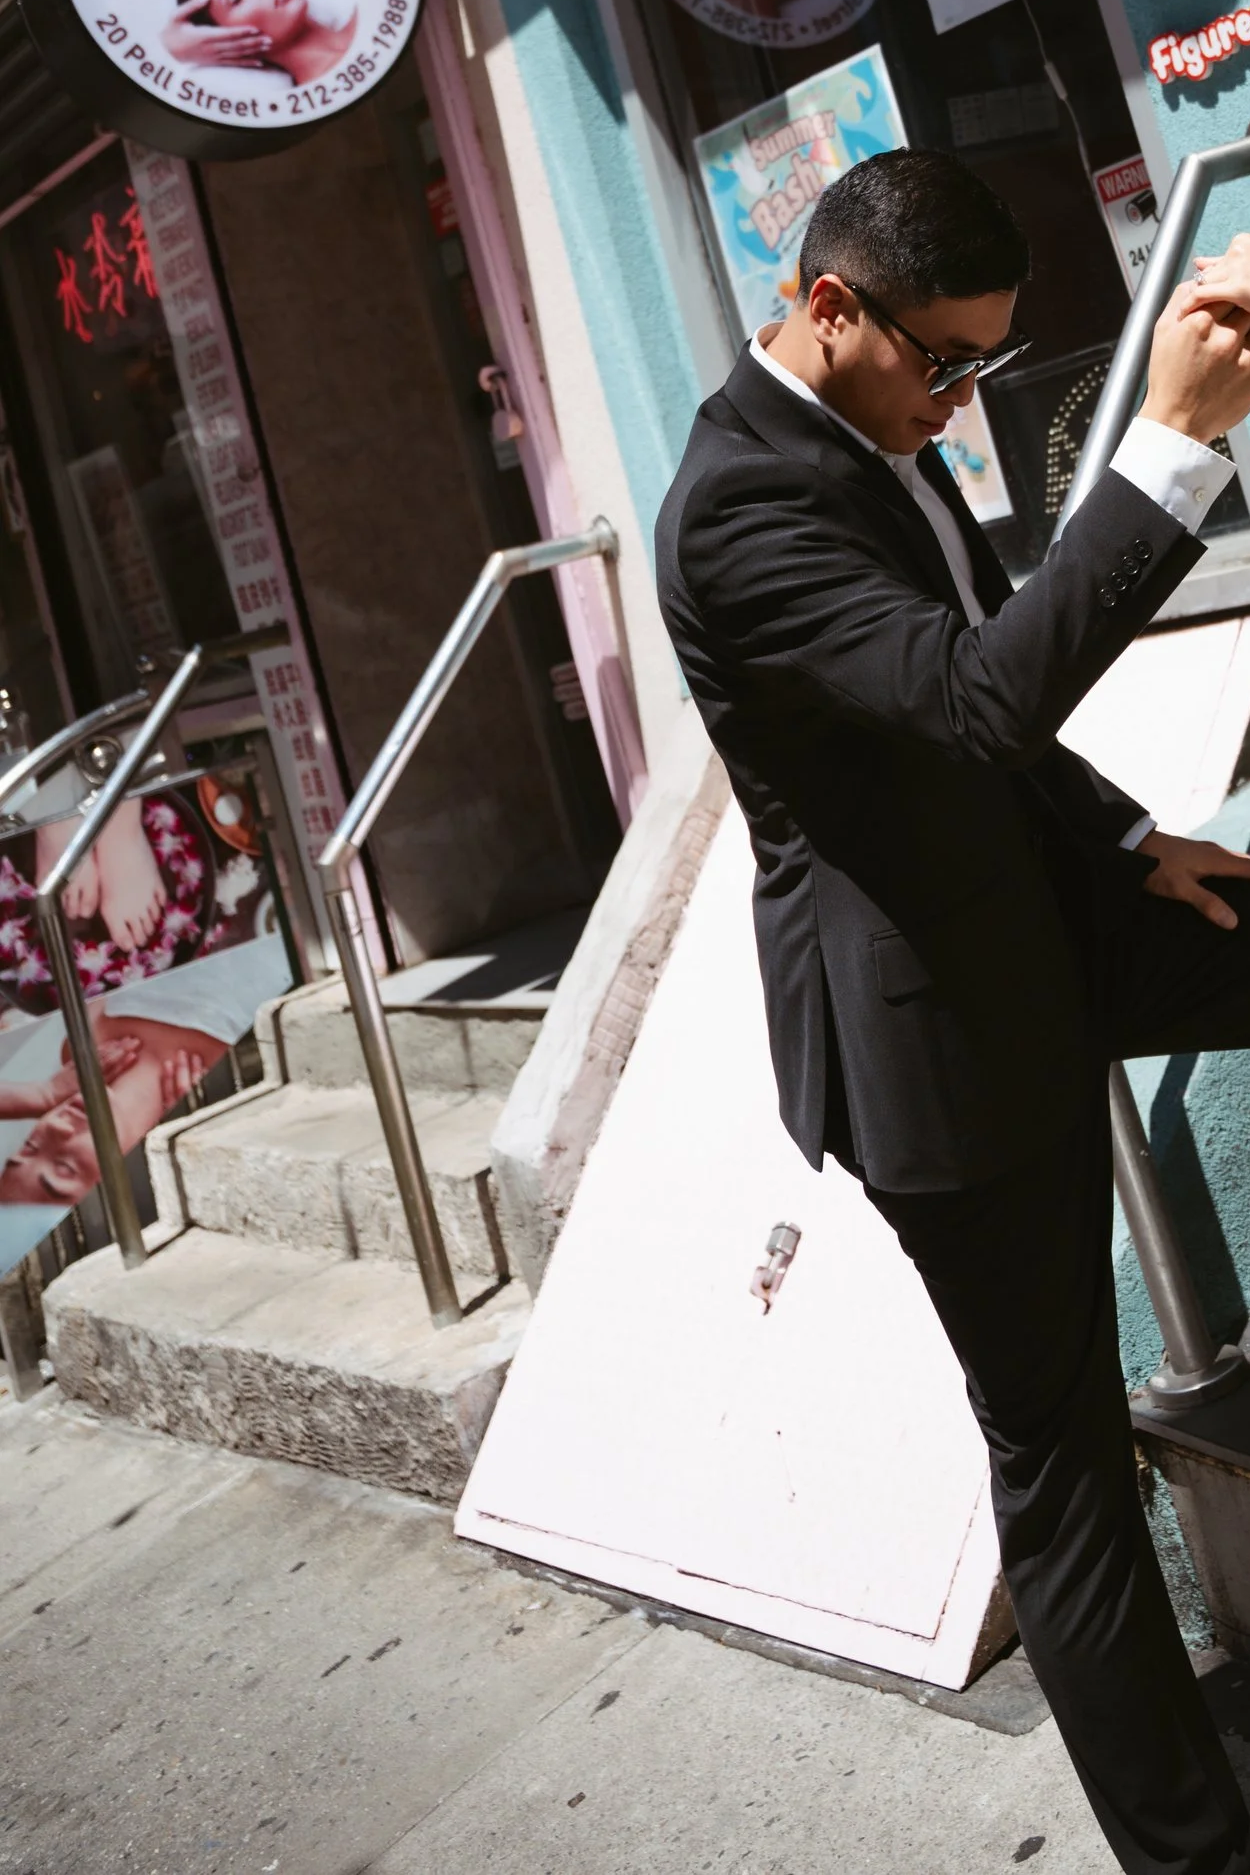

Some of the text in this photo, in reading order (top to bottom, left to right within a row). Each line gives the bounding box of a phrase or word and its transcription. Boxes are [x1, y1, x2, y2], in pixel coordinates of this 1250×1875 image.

[96, 13, 129, 46] 20
[123, 43, 174, 92] Pell
[177, 81, 260, 119] Street
[749, 111, 837, 168] Summer
[749, 163, 823, 251] Bash
[1101, 164, 1150, 199] WARNI
[1129, 246, 1146, 267] 24
